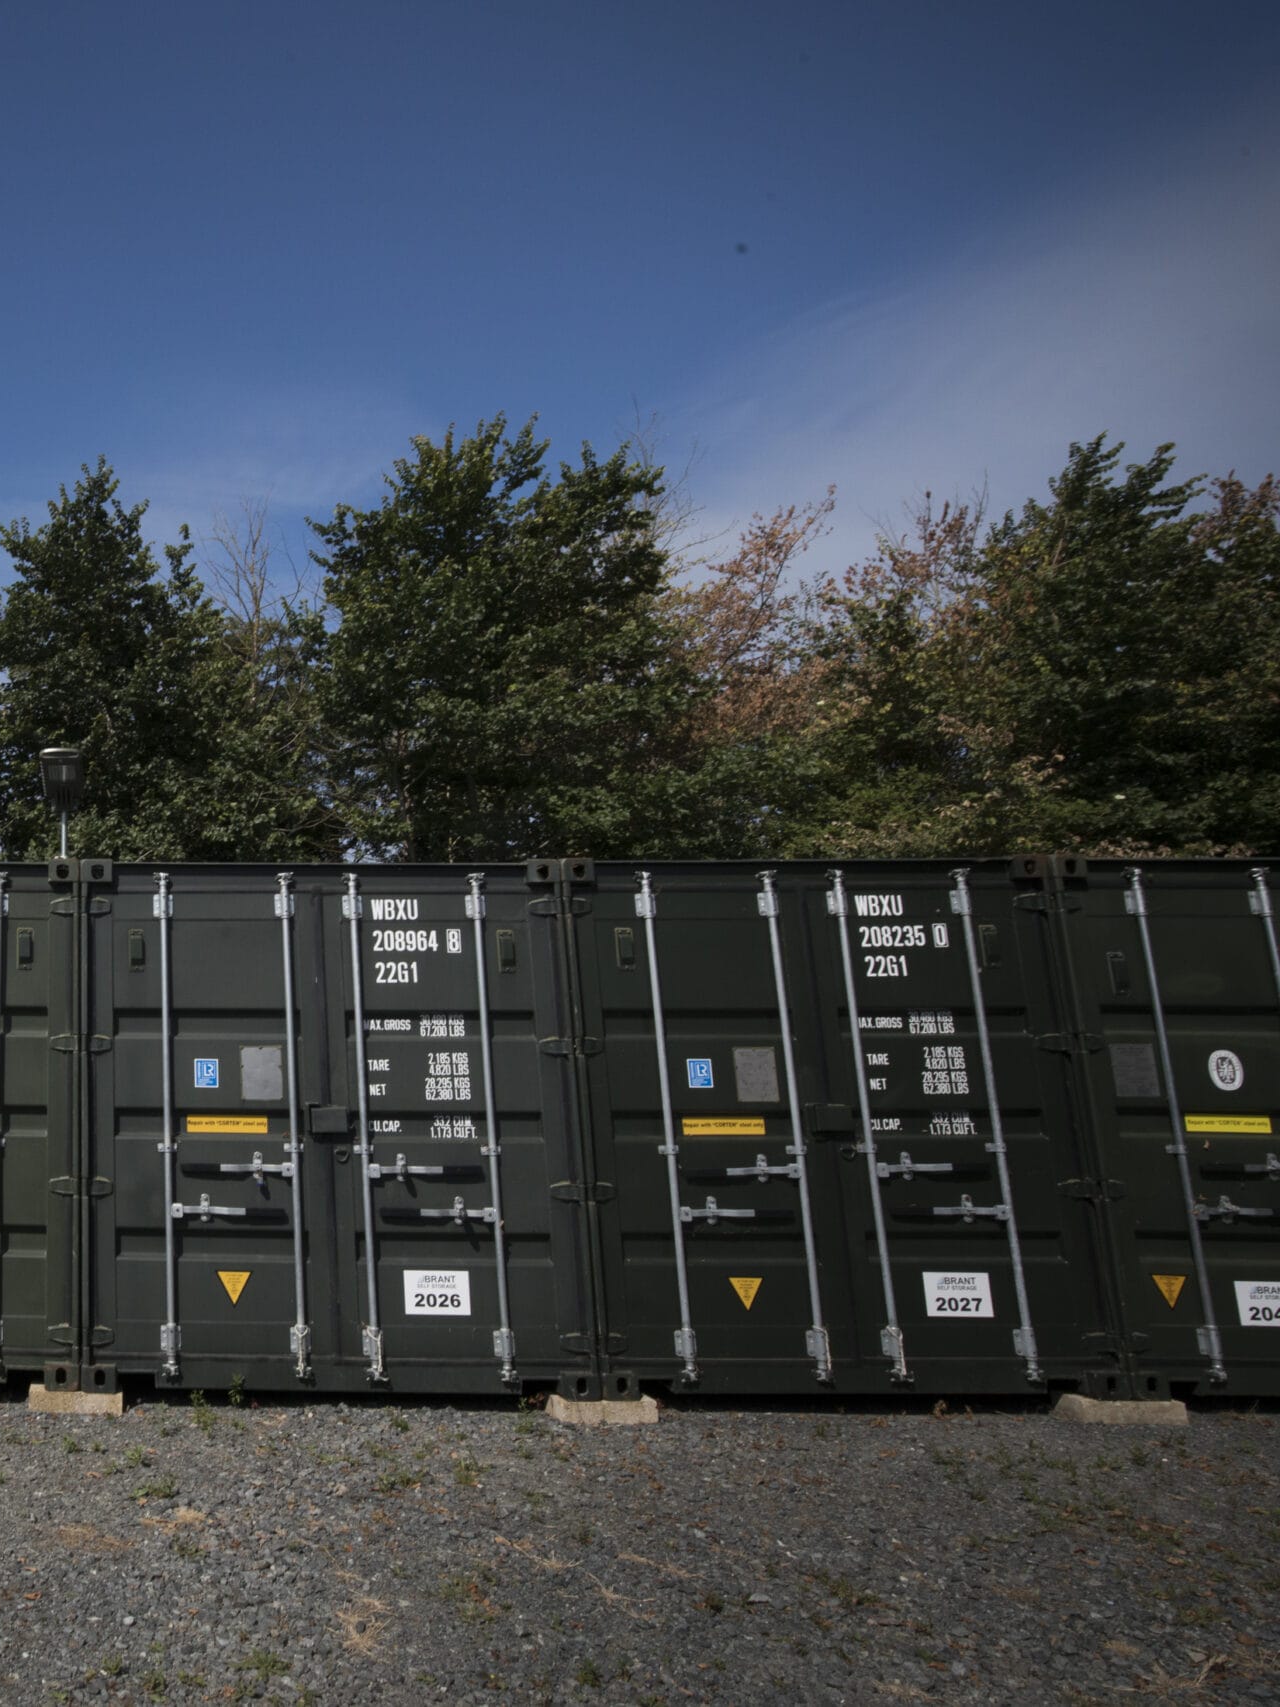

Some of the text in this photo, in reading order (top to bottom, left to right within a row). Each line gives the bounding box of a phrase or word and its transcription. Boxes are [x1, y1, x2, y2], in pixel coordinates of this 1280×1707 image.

[371, 898, 419, 920] WBXU
[854, 894, 904, 917] WBXU
[372, 930, 460, 952] 208964 8
[859, 925, 926, 948] 208235
[375, 961, 418, 983] 22G1
[864, 955, 908, 977] 22G1
[449, 1025, 465, 1037] LBS
[938, 1022, 955, 1034] LBS
[452, 1052, 469, 1064] KGS
[947, 1046, 964, 1058] KGS
[367, 1059, 390, 1071] TARE
[866, 1053, 889, 1065] TARE
[949, 1058, 966, 1069] LBS
[453, 1064, 469, 1075] LBS
[454, 1077, 470, 1088] KGS
[951, 1071, 968, 1083] KGS
[369, 1083, 387, 1096] NET
[870, 1078, 887, 1090] NET
[953, 1083, 969, 1094] LBS
[455, 1088, 471, 1100] LBS
[414, 1293, 461, 1308] 2026
[936, 1297, 983, 1312] 2027
